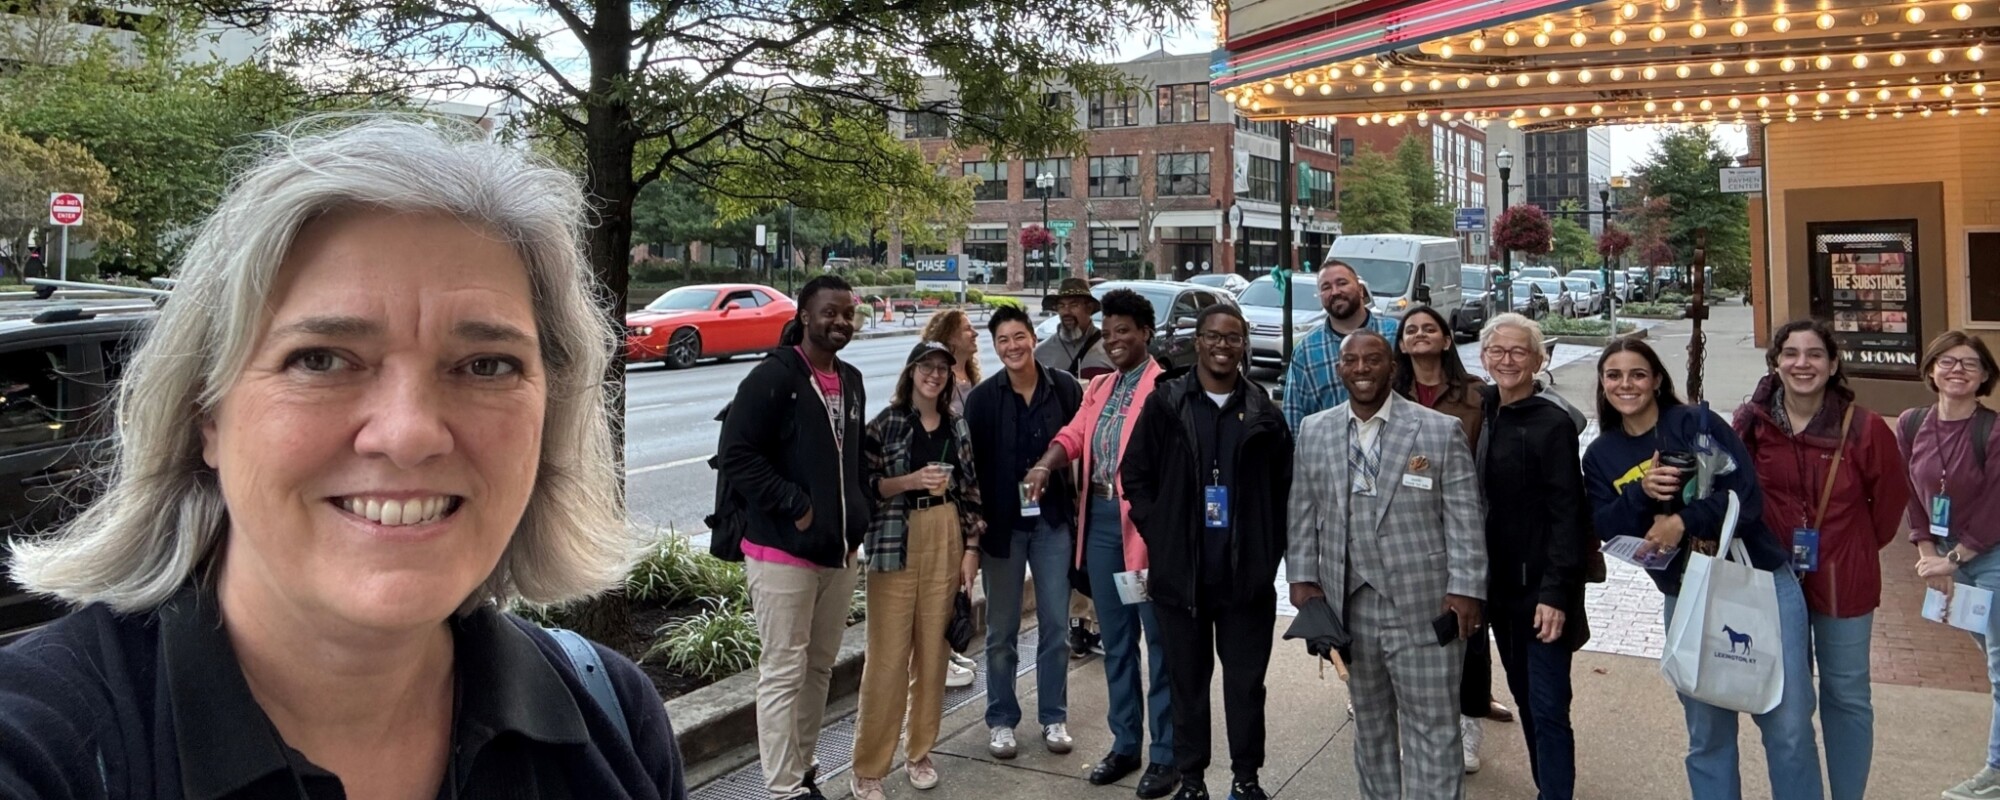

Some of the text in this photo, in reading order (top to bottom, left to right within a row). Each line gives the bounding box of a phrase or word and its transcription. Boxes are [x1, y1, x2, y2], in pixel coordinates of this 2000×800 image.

[916, 260, 946, 272] CHASE
[1832, 274, 1906, 290] THE SUBSTANCE
[1714, 651, 1748, 664] LEXINGTON,
